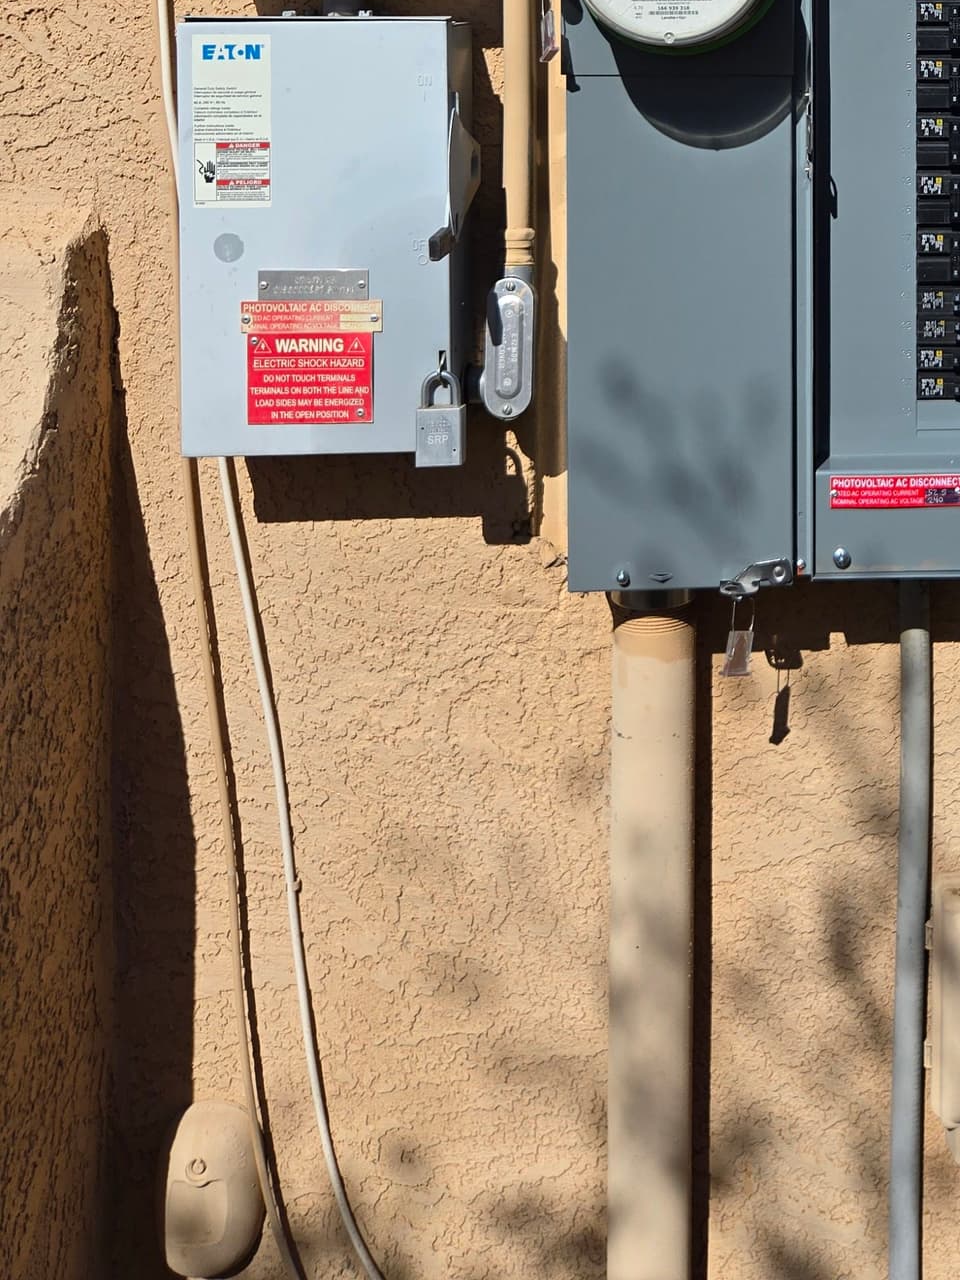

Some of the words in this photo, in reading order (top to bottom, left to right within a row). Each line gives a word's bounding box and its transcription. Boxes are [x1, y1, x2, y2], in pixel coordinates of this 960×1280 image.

[202, 44, 261, 60] EATON
[243, 303, 307, 313] PHOTOVOLTAIC
[309, 303, 322, 313] AC
[272, 314, 304, 322] OPERATING
[275, 338, 344, 353] WARNING
[253, 358, 296, 368] ELECTRIC
[298, 358, 328, 368] SHOCK
[330, 358, 365, 368] HAZARD
[264, 374, 274, 383] DO
[276, 374, 290, 383] NOT
[292, 374, 316, 382] TOUCH
[317, 374, 356, 382] TERMINALS
[250, 387, 289, 395] TERMINALS
[355, 386, 370, 394] AND
[255, 399, 274, 407] LOAD
[276, 399, 297, 407] SIDES
[298, 399, 313, 407] MAY
[324, 398, 365, 406] ENERGIZED
[271, 411, 278, 419] IN
[280, 411, 294, 419] THE
[295, 411, 315, 419] OPEN
[316, 410, 349, 418] POSITION
[427, 434, 449, 445] SRP
[832, 479, 894, 488] PHOTOVOLTAIC
[896, 478, 909, 488] AC
[860, 489, 892, 497] OPERATING
